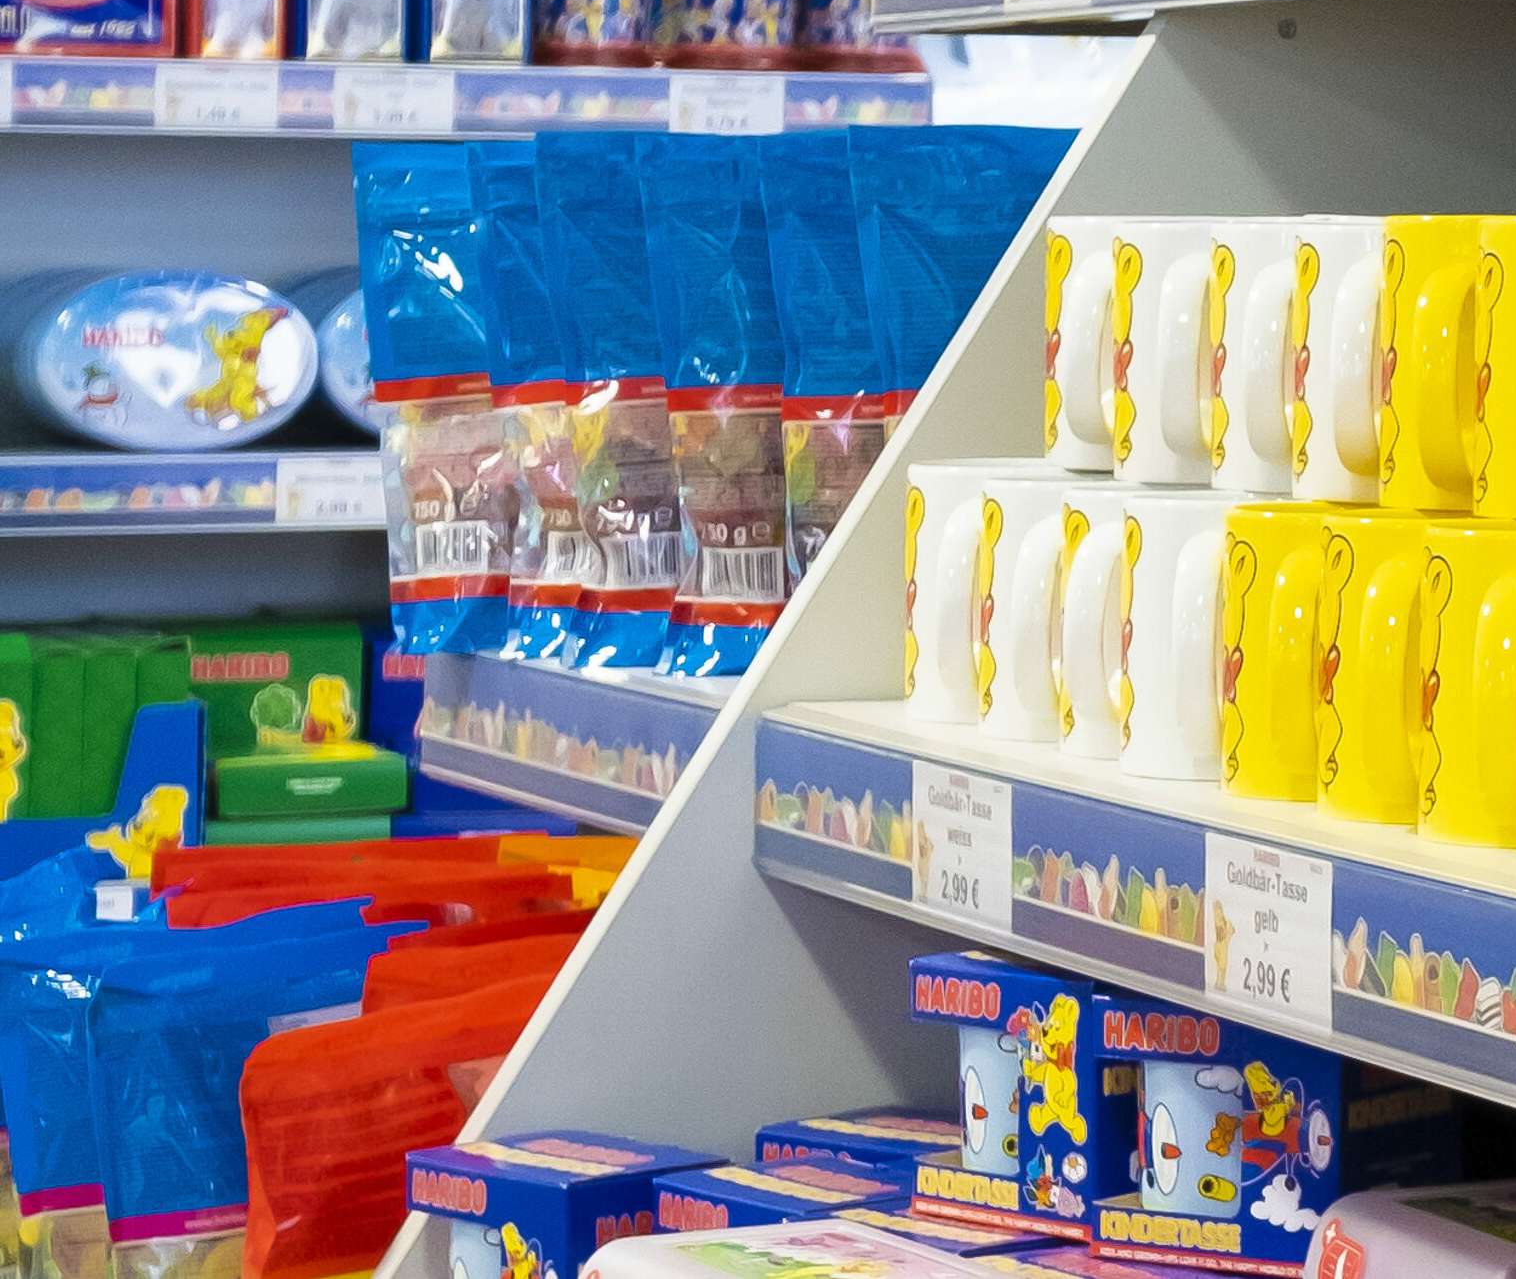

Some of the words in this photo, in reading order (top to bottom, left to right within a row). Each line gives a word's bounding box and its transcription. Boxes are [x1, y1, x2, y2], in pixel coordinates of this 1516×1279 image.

[942, 870, 968, 905] 2,99
[972, 878, 980, 909] €
[1254, 909, 1279, 934] gelb
[915, 974, 1001, 1021] HARIBO
[1243, 957, 1276, 998] 2,99
[1281, 968, 1291, 1003] €
[1104, 1010, 1220, 1056] HARIBO
